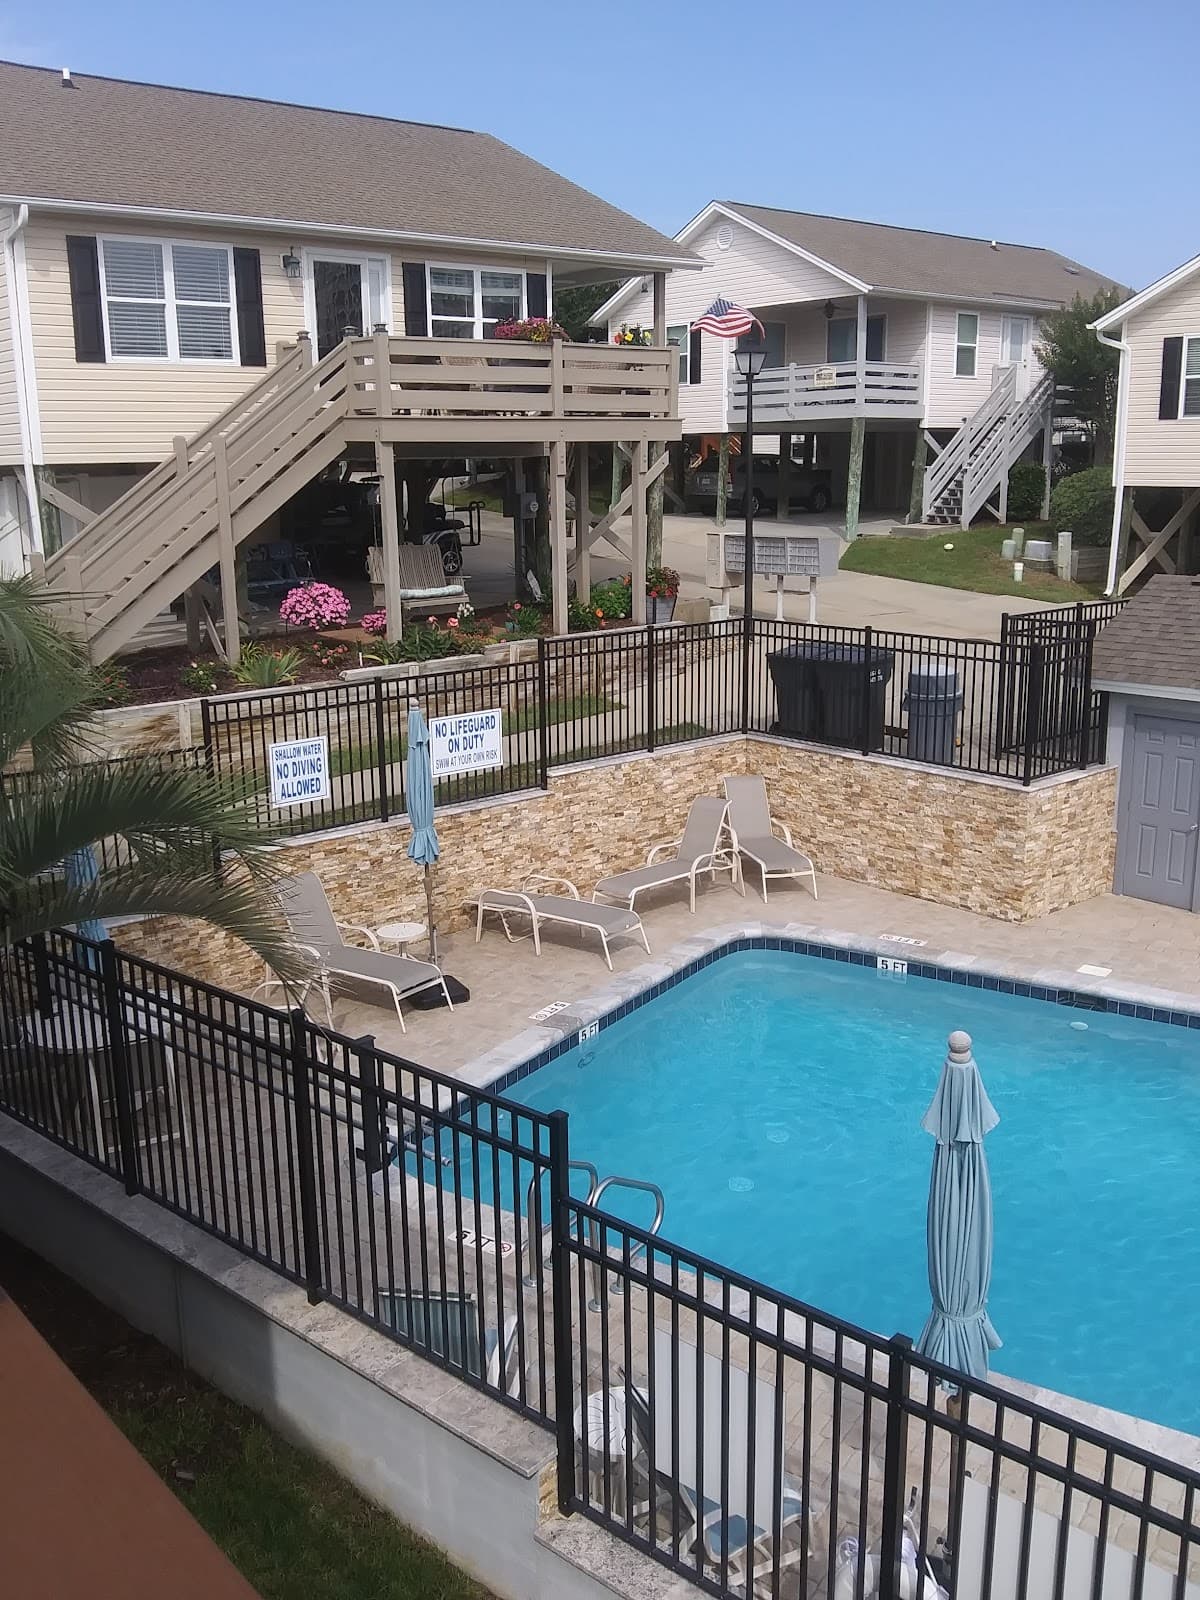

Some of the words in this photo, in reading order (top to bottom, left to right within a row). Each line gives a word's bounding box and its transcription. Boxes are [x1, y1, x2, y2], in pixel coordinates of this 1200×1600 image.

[435, 722, 447, 738] NO
[450, 715, 496, 736] LIFEGUARD
[275, 746, 301, 761] SHALLOW
[302, 743, 321, 756] WATER
[448, 737, 460, 753] ON
[462, 733, 484, 751] DUTY
[276, 763, 289, 780] NO
[292, 757, 322, 777] DIVING
[435, 757, 449, 769] SWIM
[450, 756, 457, 766] AT
[457, 753, 472, 764] YOUR
[473, 751, 485, 762] OWN
[486, 748, 498, 759] RISK
[281, 777, 321, 800] ALLOWED
[881, 959, 889, 970] 5
[893, 961, 906, 974] FT
[581, 1029, 587, 1041] 5
[589, 1022, 598, 1037] FT
